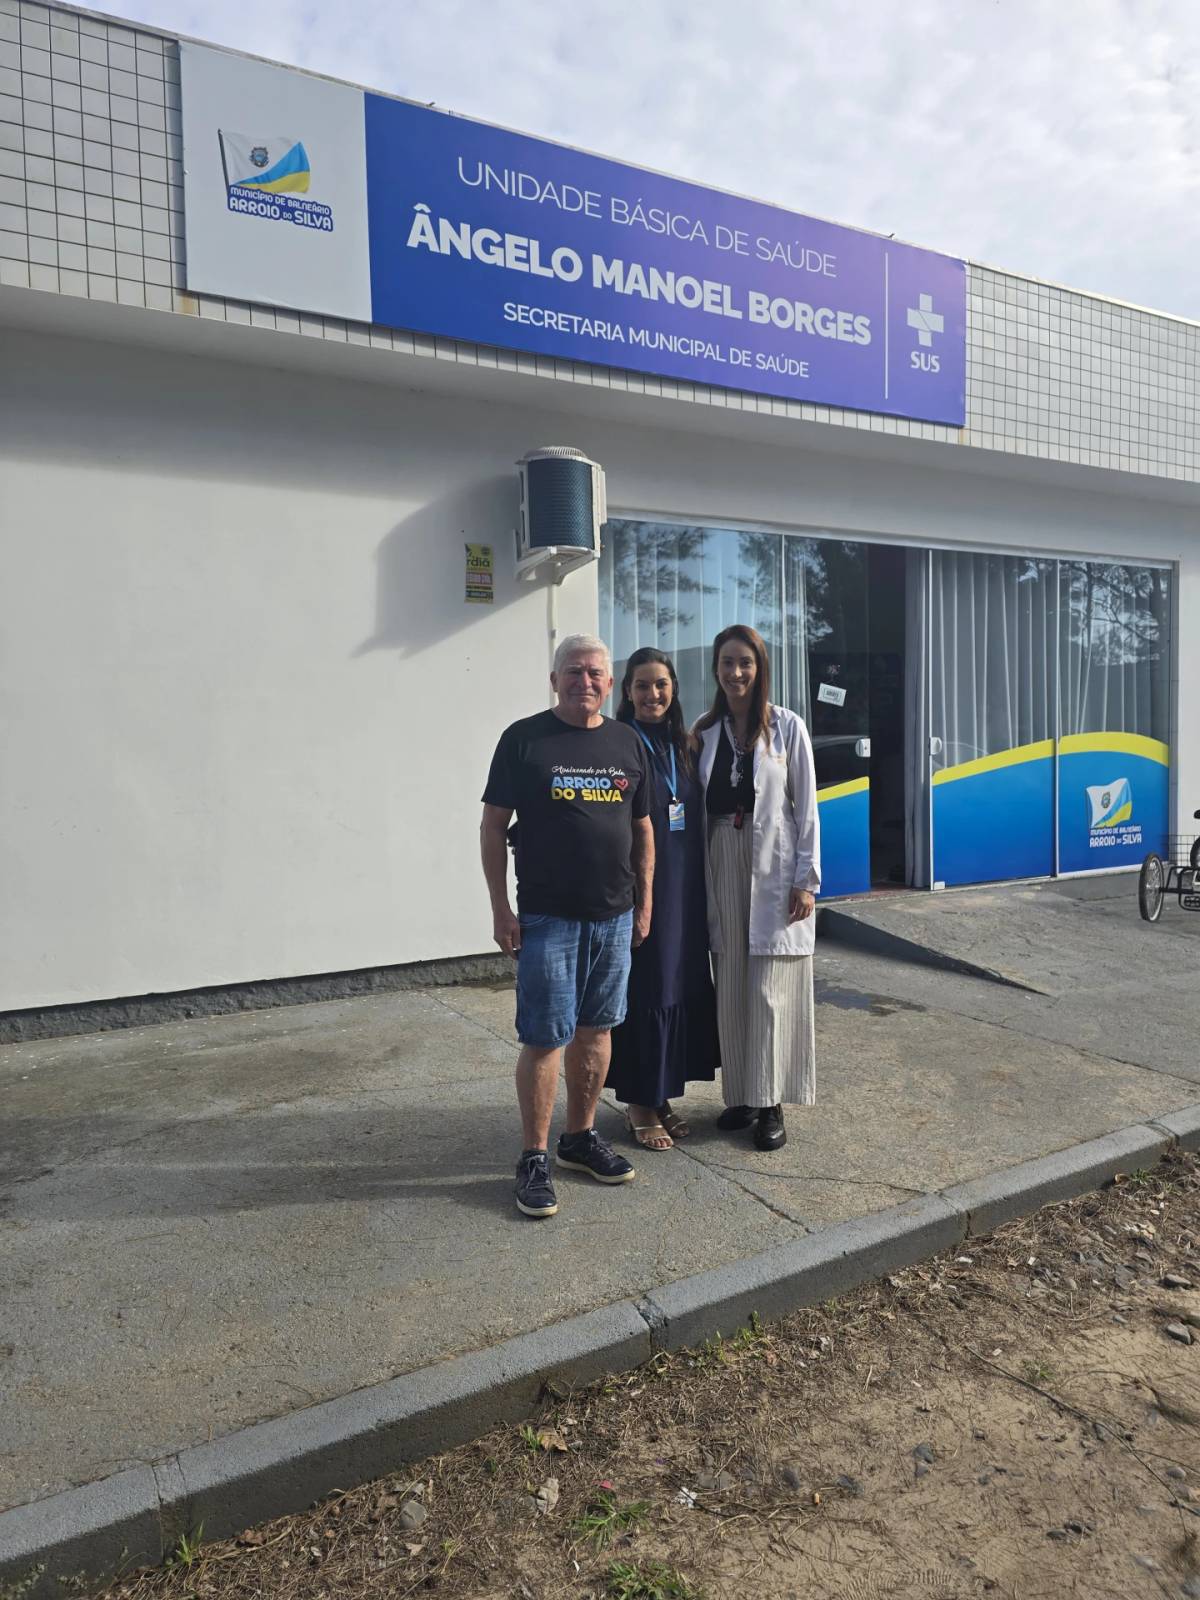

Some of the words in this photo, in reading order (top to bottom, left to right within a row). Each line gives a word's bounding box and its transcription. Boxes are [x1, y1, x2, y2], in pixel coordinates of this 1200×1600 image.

[229, 197, 280, 219] ARROIO
[282, 211, 292, 220] DO
[294, 210, 332, 230] SILVA
[275, 196, 286, 206] DE
[287, 199, 330, 215] BALNEÁRIO
[458, 156, 602, 218] UNIDADE
[611, 198, 709, 246] BÁSICA
[715, 225, 750, 256] DE
[756, 240, 837, 278] SAÚDE
[406, 203, 583, 282] ÂNGELO
[592, 254, 742, 320] MANOEL
[748, 291, 872, 346] BORGES
[503, 302, 625, 343] SECRETARIA
[629, 327, 726, 362] MUNICIPAL
[729, 347, 751, 367] DE
[755, 353, 809, 378] SAÚDE
[910, 351, 940, 373] SUS
[595, 767, 607, 776] por
[552, 776, 611, 789] ARROIO
[551, 788, 575, 800] DO
[581, 789, 623, 802] SILVA
[1090, 836, 1115, 847] ARROIO
[1122, 834, 1142, 845] SILVA
